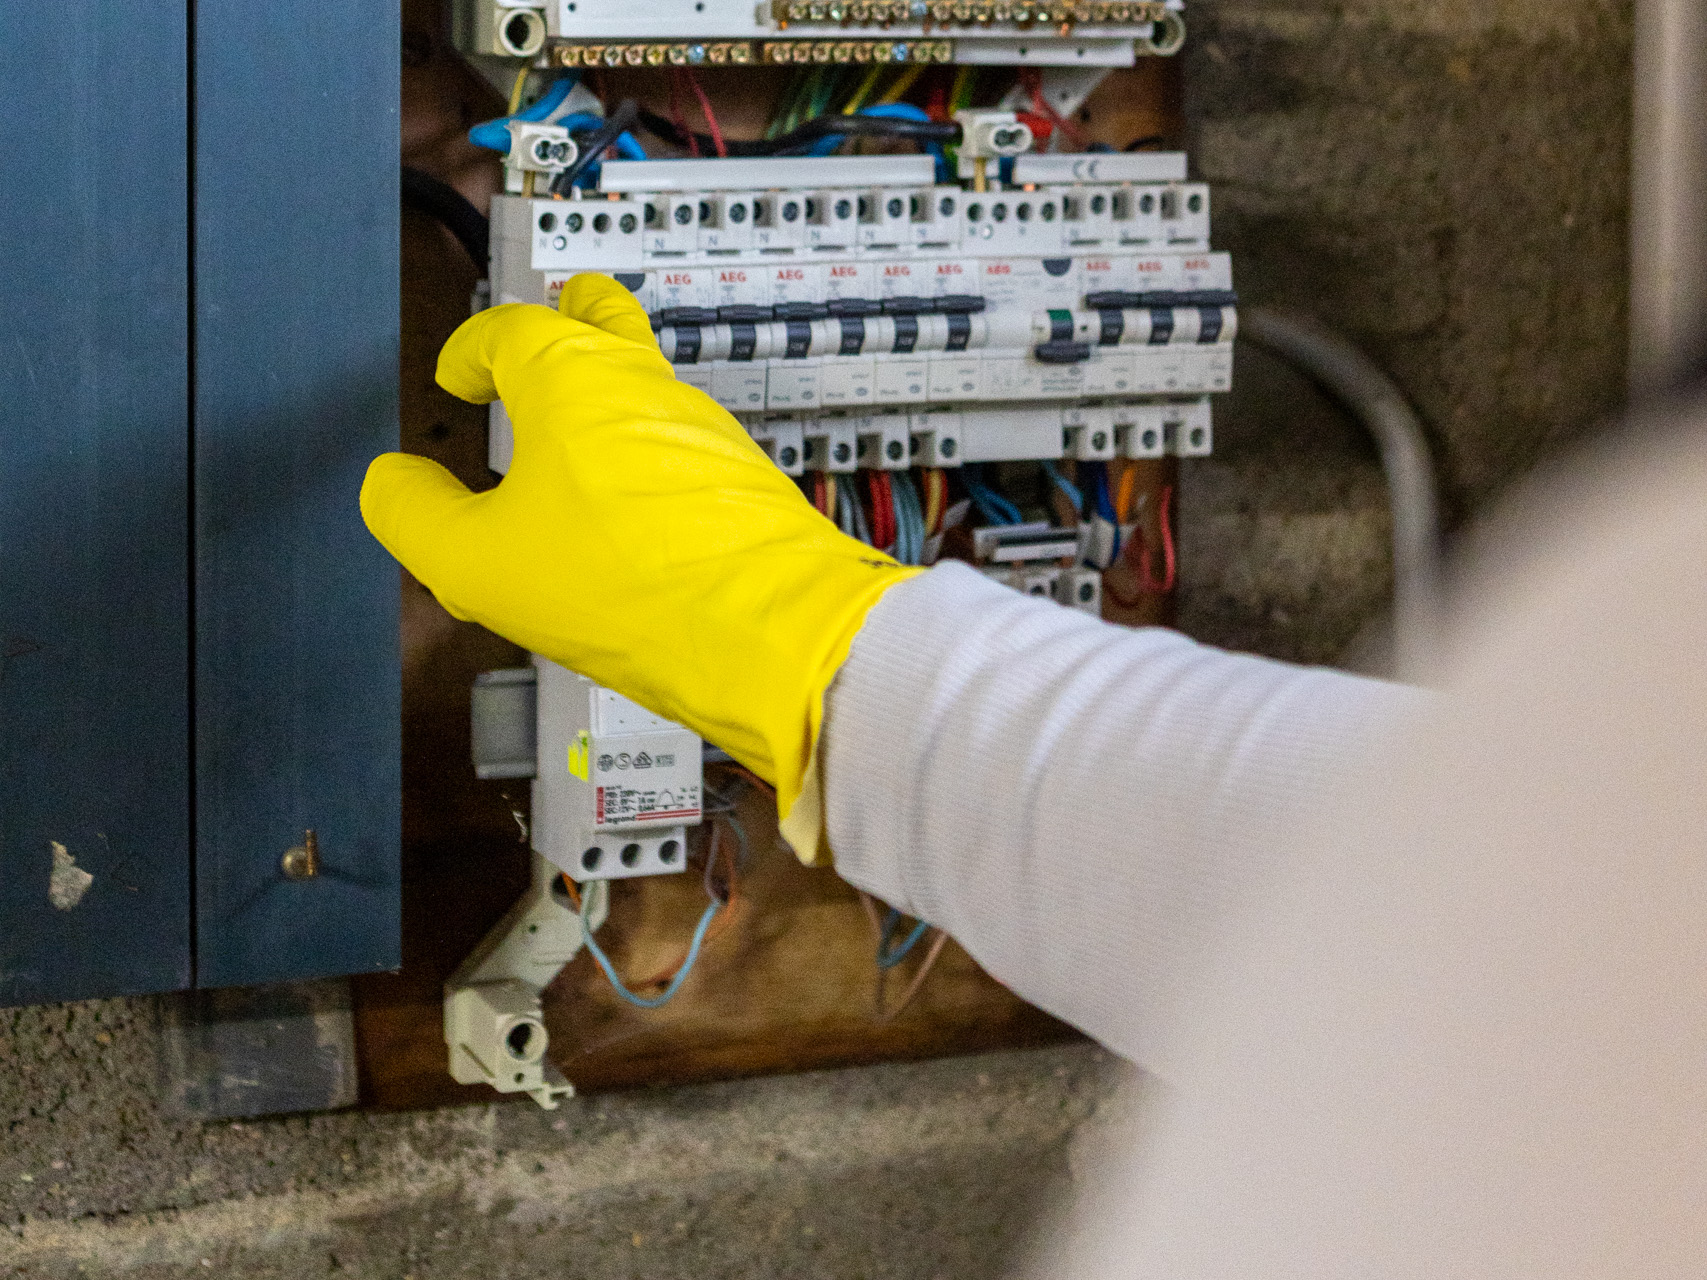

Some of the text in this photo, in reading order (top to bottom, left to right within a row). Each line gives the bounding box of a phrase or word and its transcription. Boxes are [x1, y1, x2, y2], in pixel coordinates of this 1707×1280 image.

[708, 236, 719, 246] N
[759, 232, 770, 244] N
[655, 238, 665, 249] N
[830, 267, 858, 277] AEG
[884, 266, 911, 276] AEG
[937, 264, 963, 275] AEG
[664, 274, 692, 285] AEG
[720, 272, 747, 282] AEG
[777, 270, 804, 280] AEG
